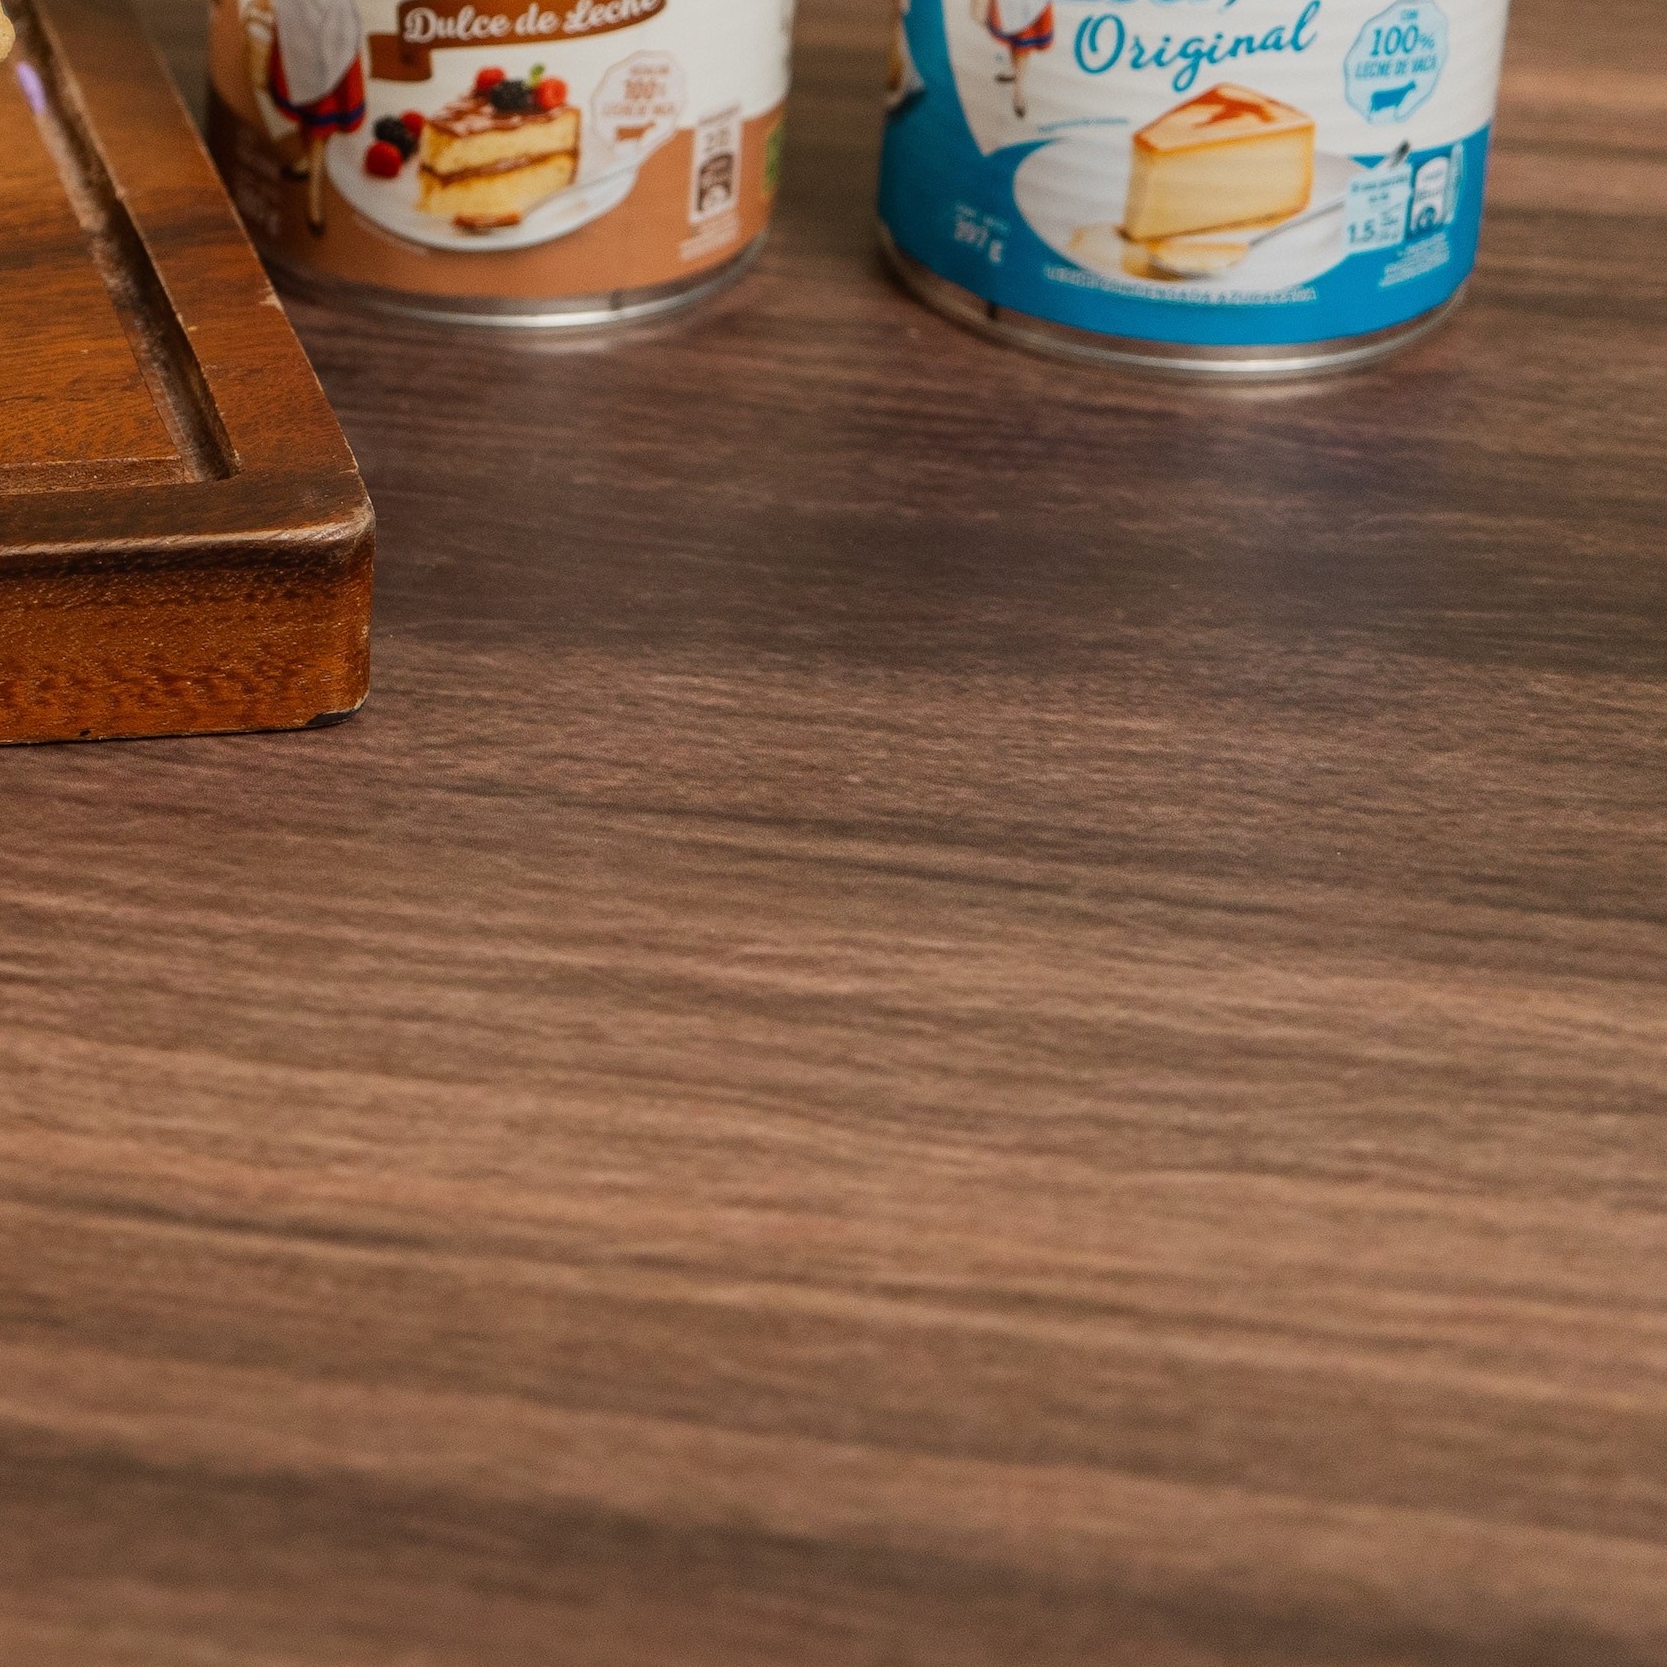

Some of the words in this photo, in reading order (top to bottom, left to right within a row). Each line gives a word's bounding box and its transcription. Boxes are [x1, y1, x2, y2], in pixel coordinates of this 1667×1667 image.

[402, 5, 511, 44] Dulce
[1370, 24, 1435, 57] 100%
[1074, 0, 1321, 93] Original
